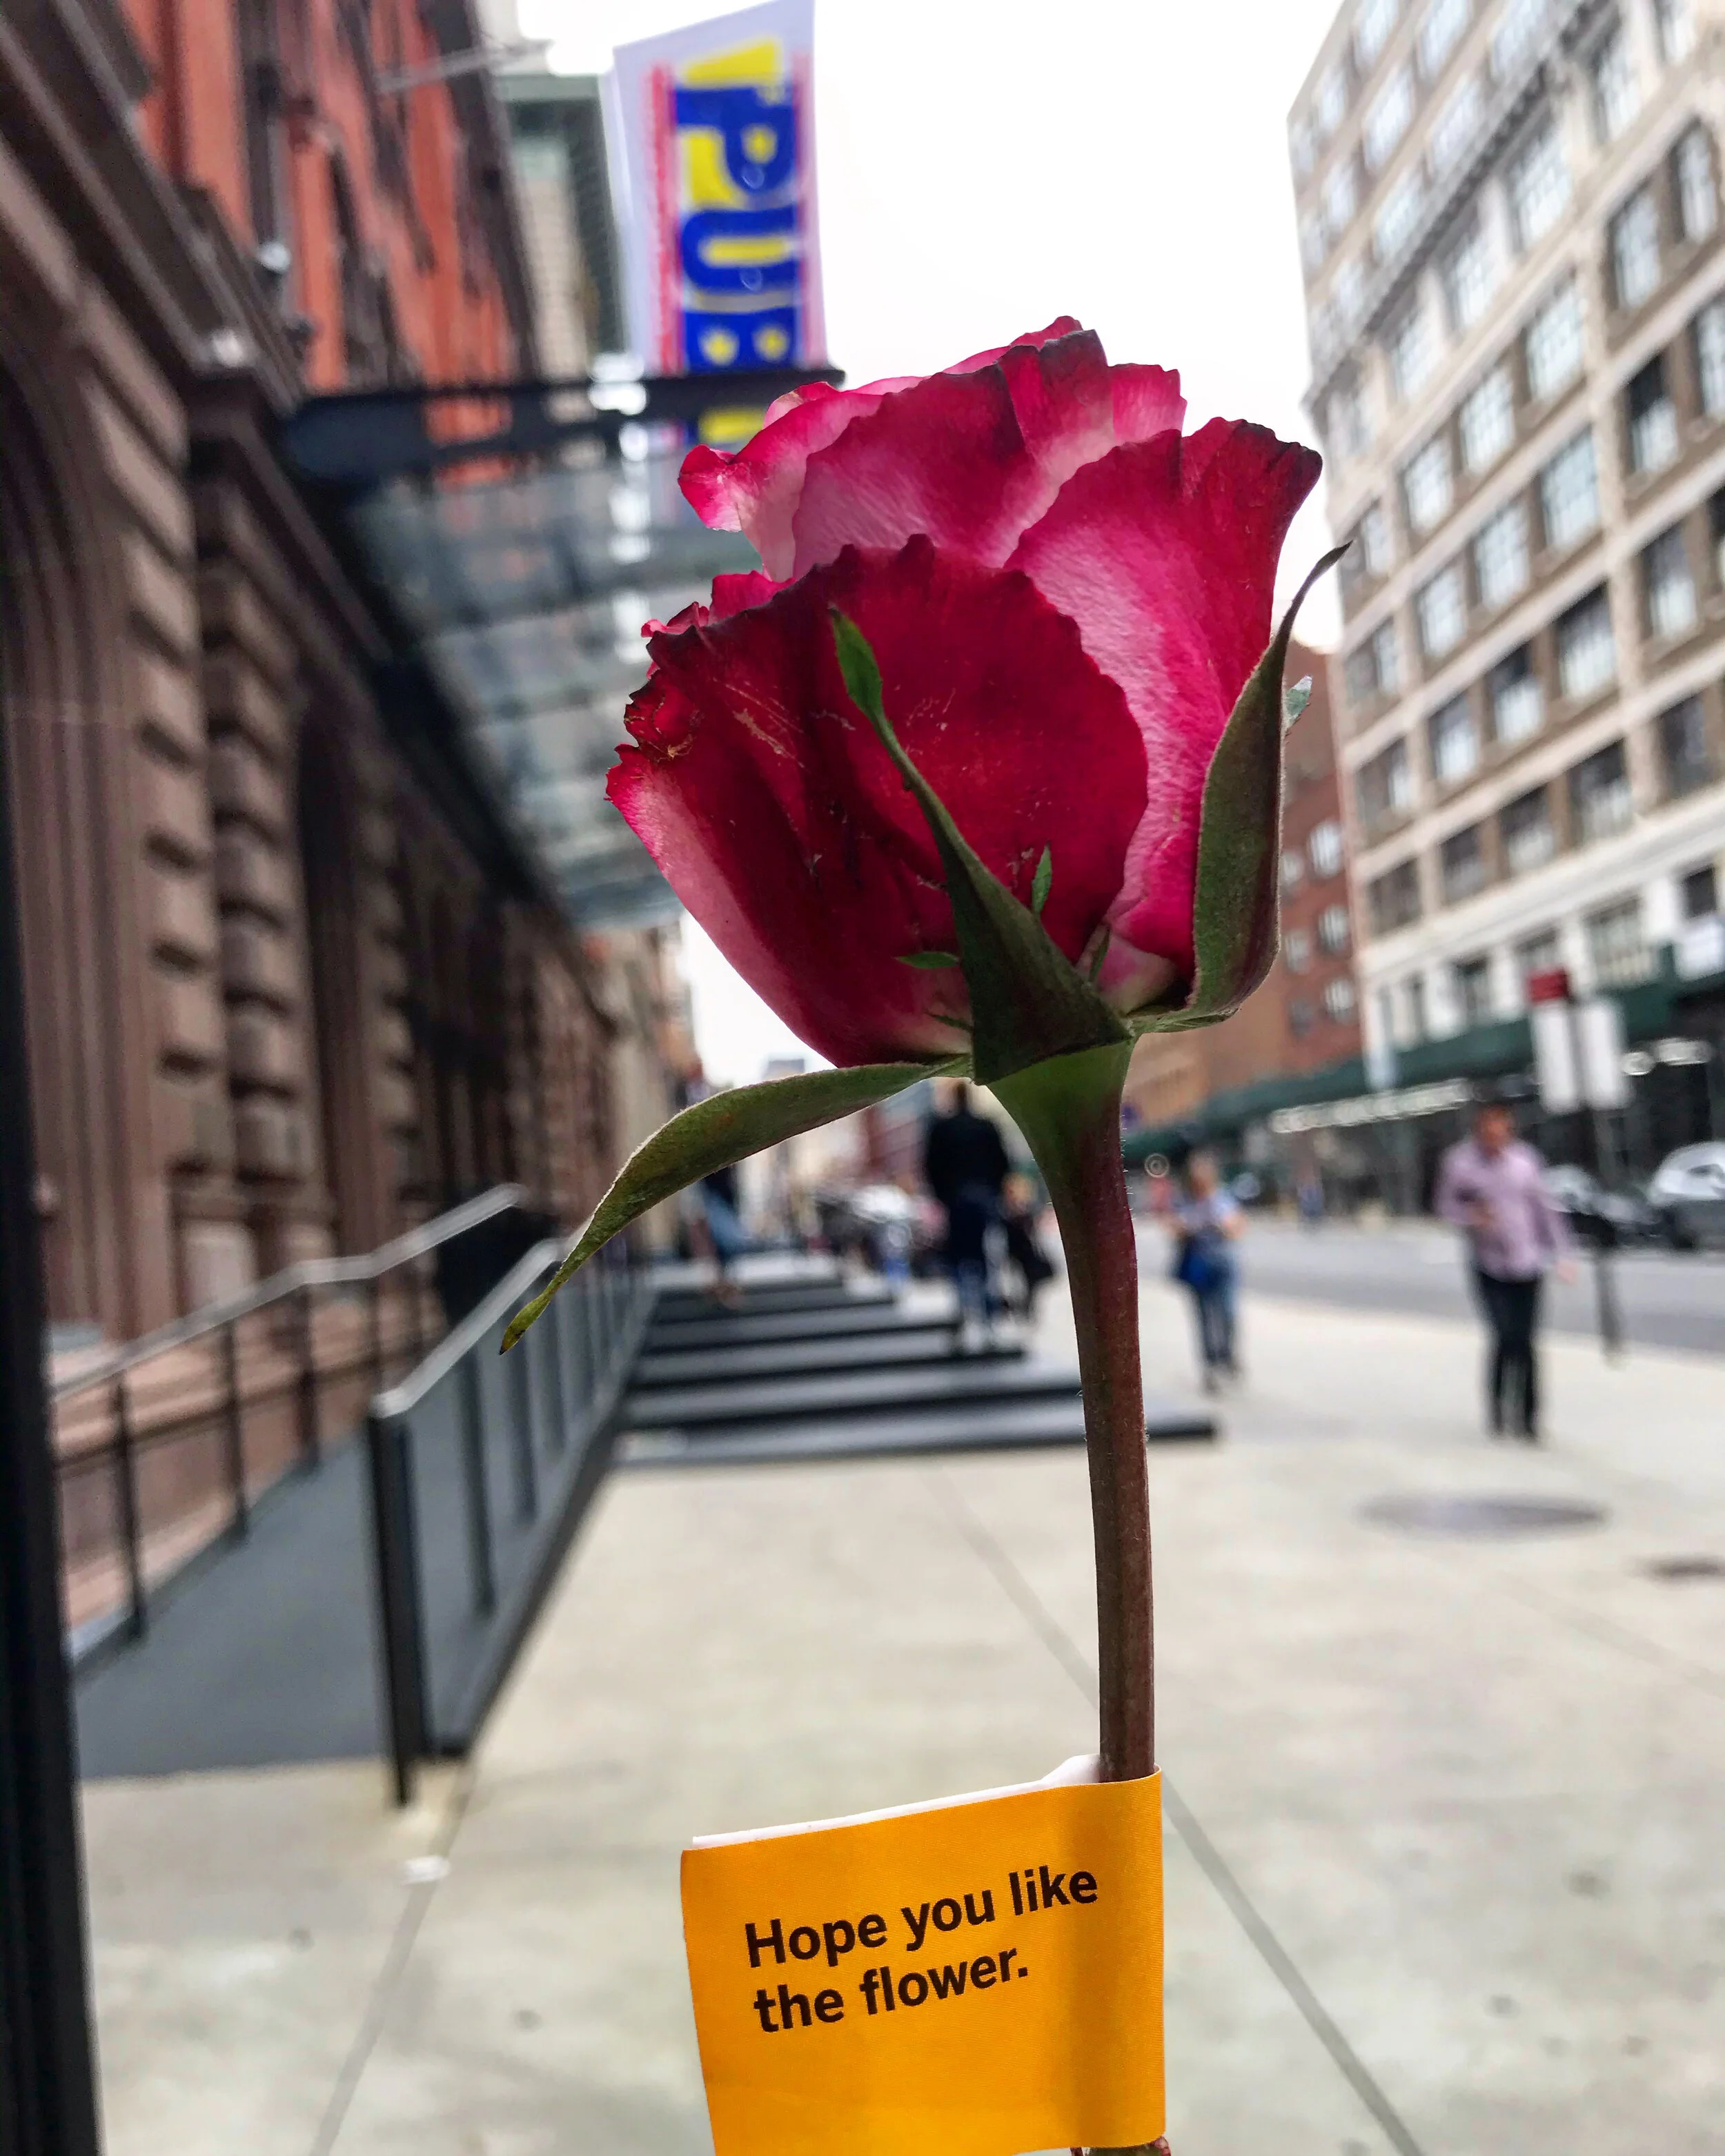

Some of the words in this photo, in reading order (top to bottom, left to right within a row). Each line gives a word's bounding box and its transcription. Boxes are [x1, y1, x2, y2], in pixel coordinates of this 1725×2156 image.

[745, 1912, 887, 1968] Hope
[900, 1889, 995, 1952] you
[1009, 1865, 1098, 1916] like
[753, 1984, 845, 2033] the
[859, 1948, 1029, 2015] flower.
